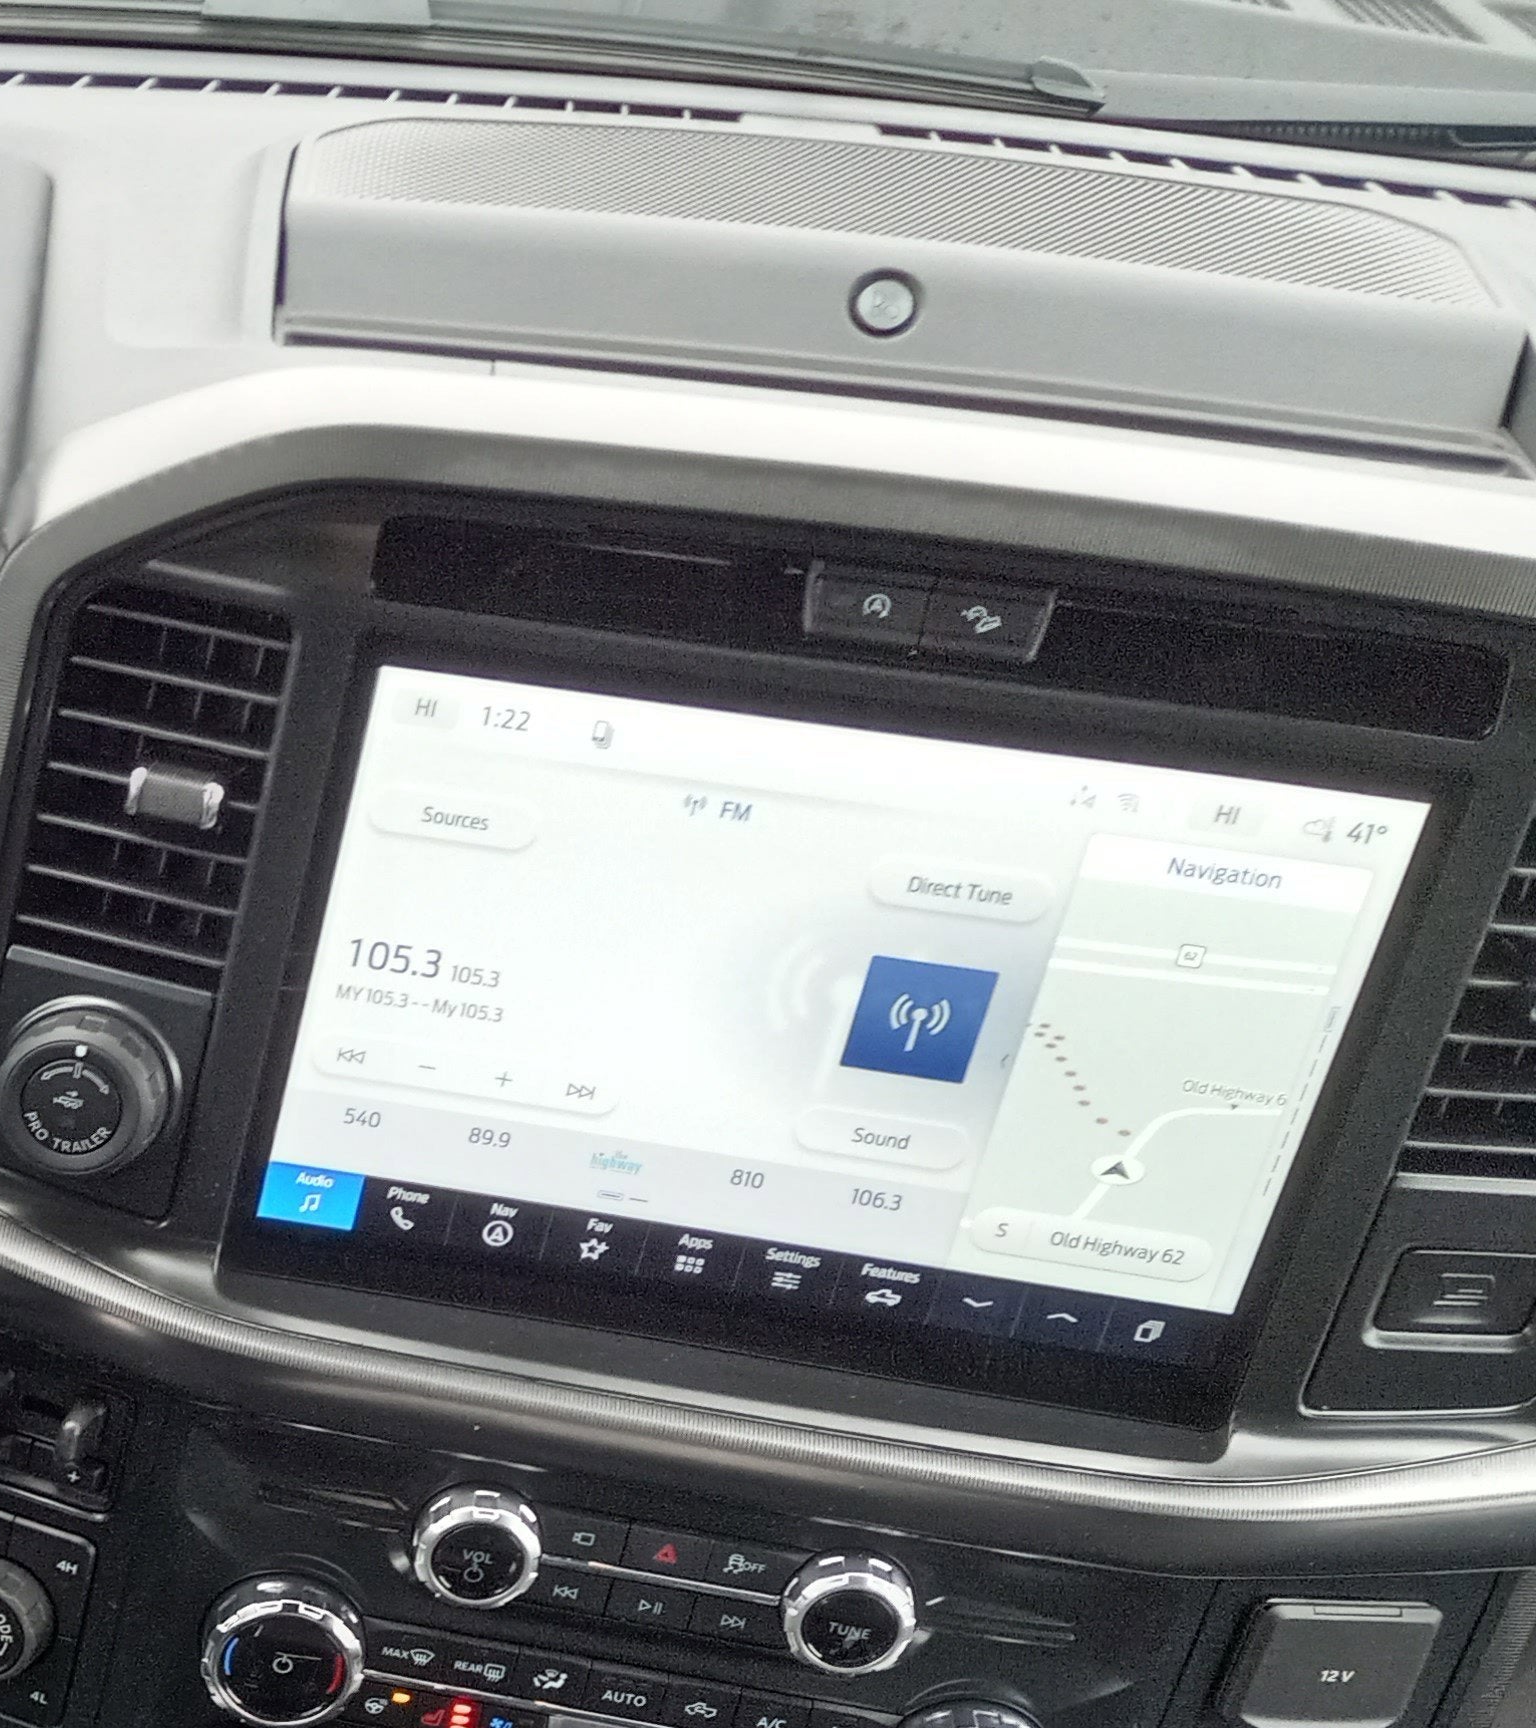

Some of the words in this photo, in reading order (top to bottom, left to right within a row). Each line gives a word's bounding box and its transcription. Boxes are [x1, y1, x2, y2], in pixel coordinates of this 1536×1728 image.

[415, 698, 438, 718] HI
[482, 705, 532, 731] 1:22
[421, 805, 490, 831] Sources
[719, 800, 753, 823] FM
[1213, 804, 1242, 826] HI
[1166, 857, 1282, 890] Navigation
[906, 874, 962, 902] Direct
[967, 882, 1014, 907] Tune
[350, 937, 443, 979] 105.3
[452, 964, 501, 989] 105.3
[335, 984, 364, 1002] MY
[366, 987, 410, 1009] 105.3
[431, 998, 459, 1018] My
[459, 1002, 505, 1023] 105.3
[1182, 1079, 1209, 1095] Old
[1212, 1084, 1275, 1107] Highway
[343, 1107, 381, 1129] 540
[23, 1110, 49, 1141] PRO
[52, 1126, 112, 1153] TRAILER
[467, 1127, 512, 1150] 89.9
[850, 1127, 912, 1150] Sound
[295, 1171, 335, 1189] Audio
[729, 1168, 766, 1190] 810
[386, 1186, 431, 1205] Phone
[850, 1187, 904, 1212] 106.3
[489, 1202, 519, 1219] Nav
[586, 1217, 614, 1234] Fav
[678, 1233, 714, 1251] Apps
[995, 1222, 1009, 1238] S
[1050, 1230, 1080, 1250] Old
[1084, 1237, 1158, 1264] Highway
[1161, 1248, 1186, 1266] 62
[765, 1247, 822, 1269] Settings
[860, 1262, 921, 1285] Features
[55, 1559, 79, 1575] 4H
[462, 1549, 494, 1566] VOL
[742, 1560, 766, 1575] OFF
[829, 1621, 872, 1640] TUNE
[382, 1646, 413, 1660] MAX
[453, 1660, 485, 1674] REAR
[29, 1690, 49, 1705] 4L
[602, 1690, 648, 1708] AUTO
